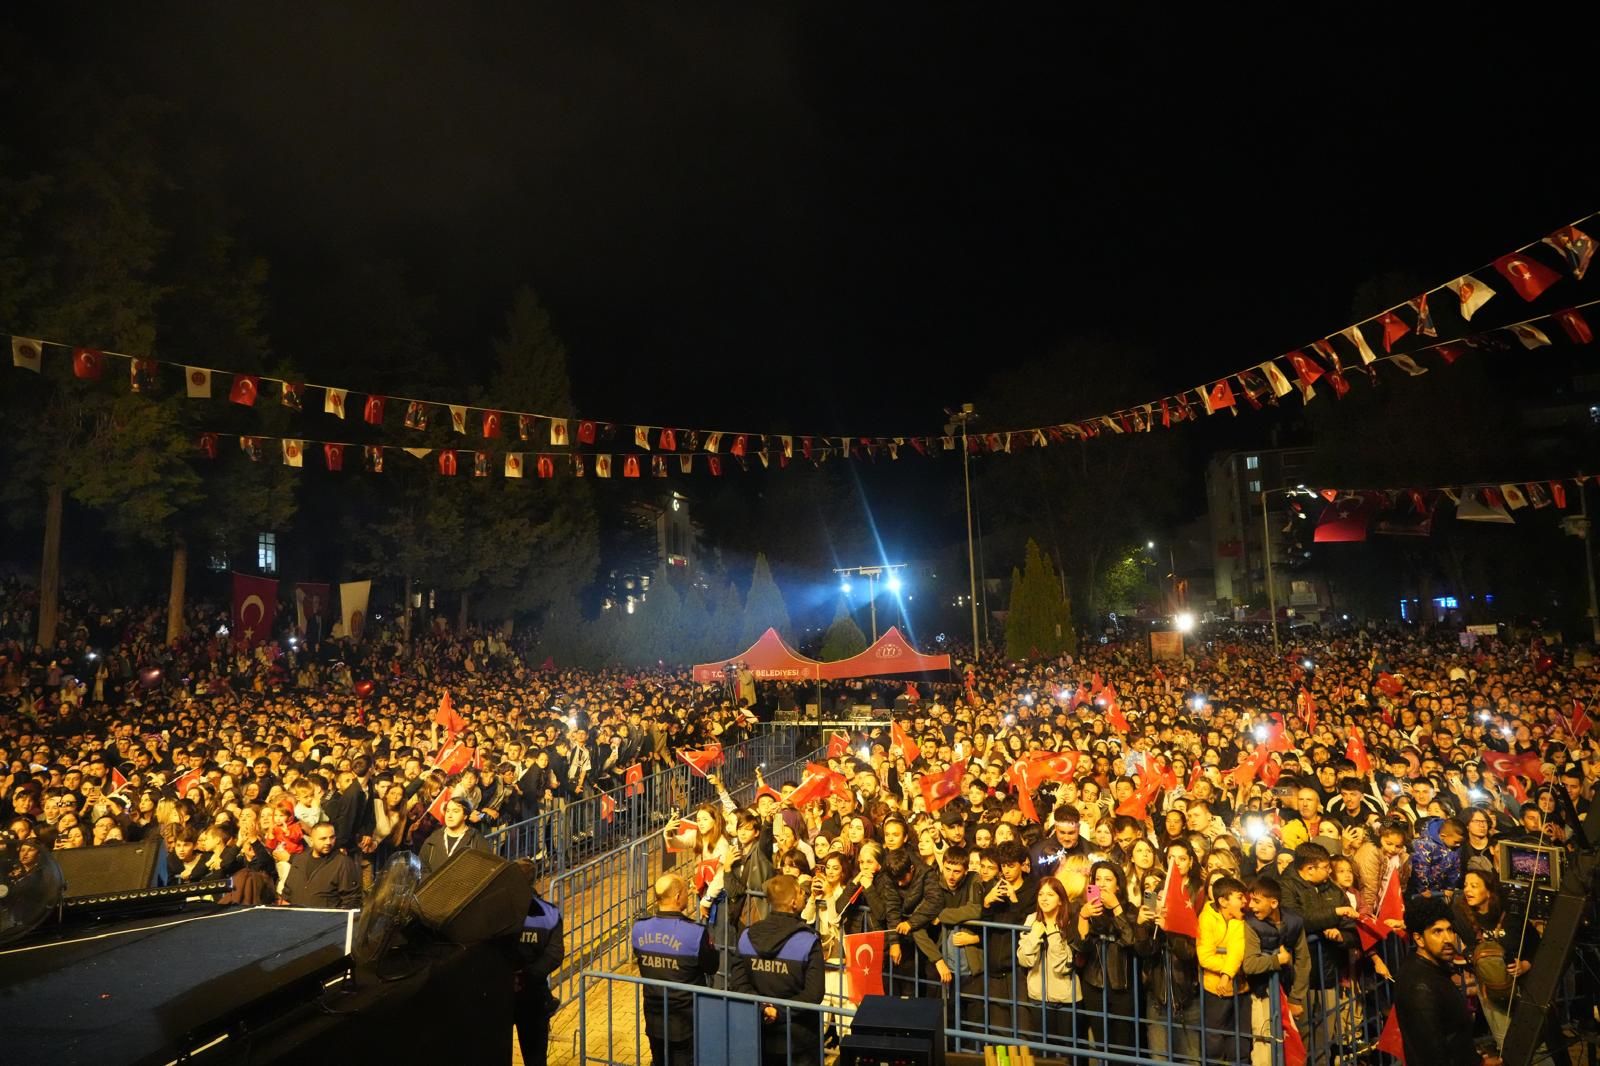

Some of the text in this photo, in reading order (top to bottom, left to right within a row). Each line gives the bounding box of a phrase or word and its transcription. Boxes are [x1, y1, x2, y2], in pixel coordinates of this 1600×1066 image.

[711, 671, 725, 679] T.C.
[755, 669, 799, 677] BELEDİYESİ
[519, 931, 538, 943] ITA
[638, 931, 682, 951] BİLECİK
[641, 954, 679, 970] ZABITA
[750, 958, 789, 974] ZABITA
